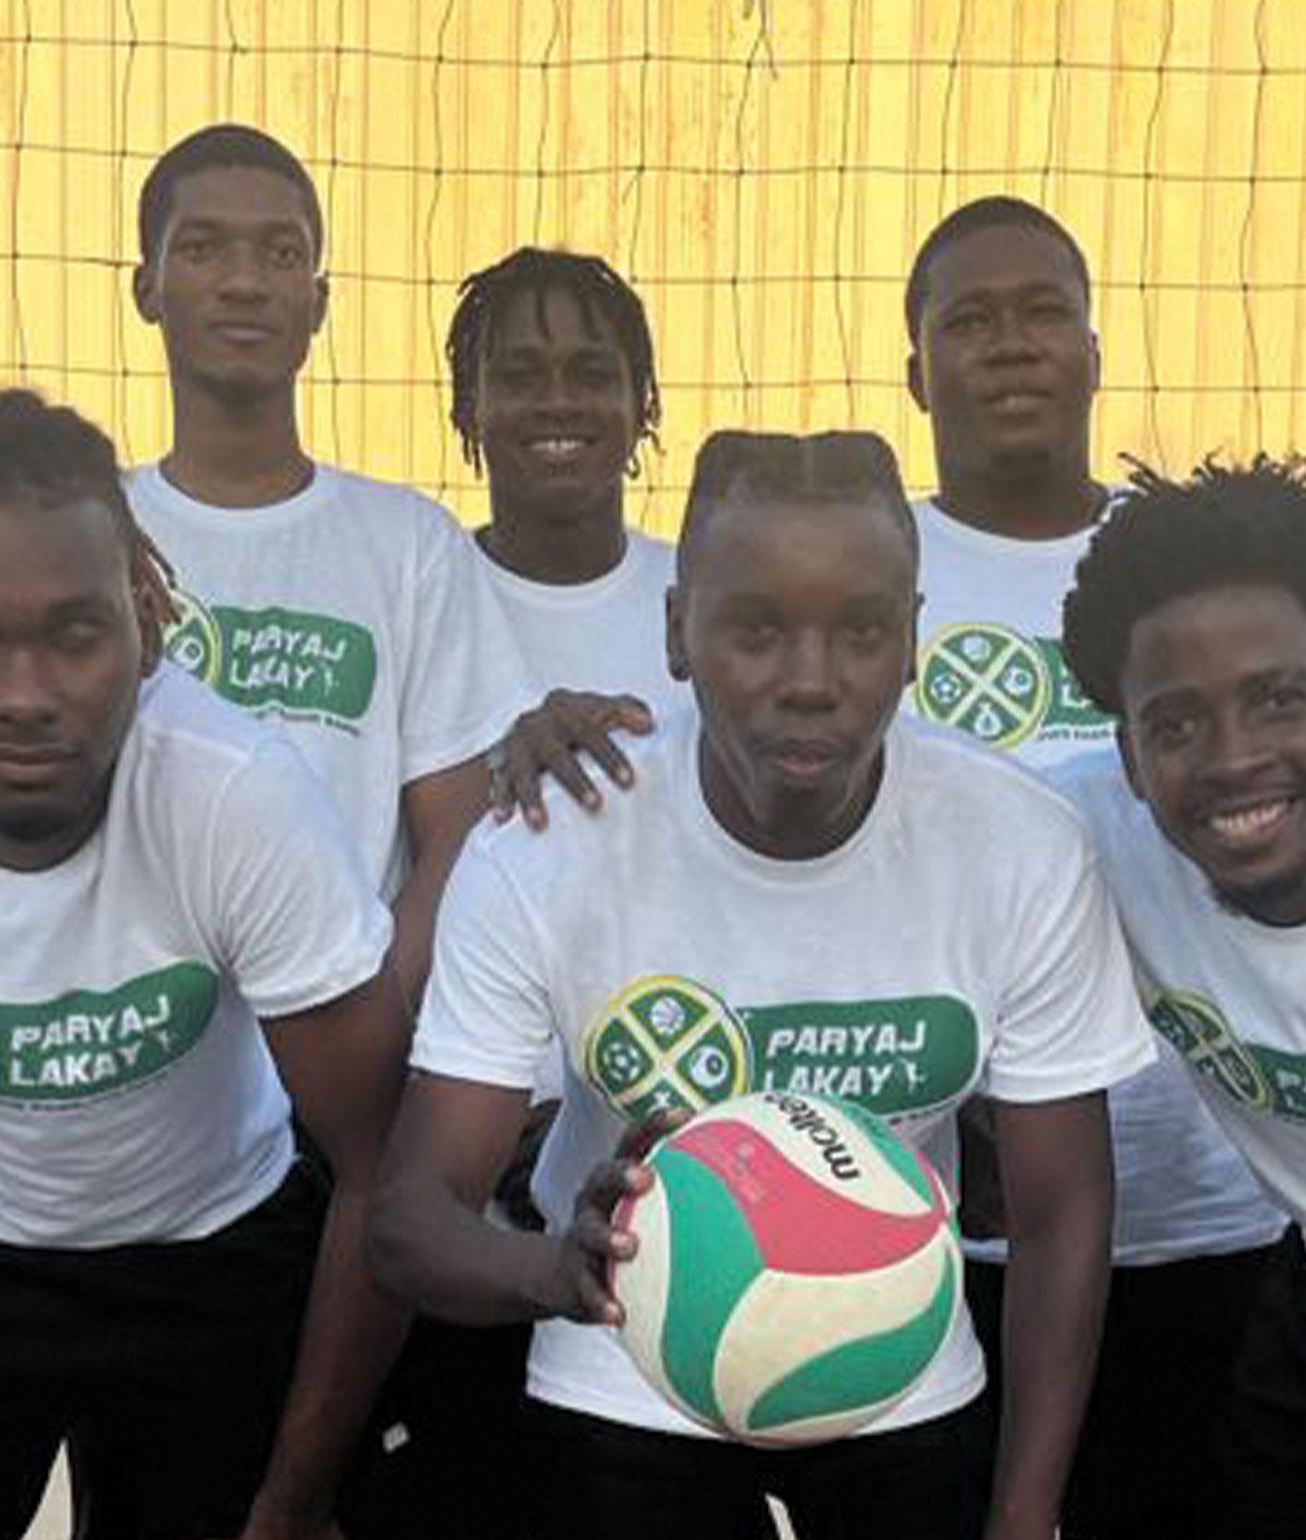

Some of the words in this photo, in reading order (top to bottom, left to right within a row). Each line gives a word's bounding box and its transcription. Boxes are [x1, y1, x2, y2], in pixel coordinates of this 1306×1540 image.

[11, 994, 170, 1049] PARYAJ
[766, 1020, 926, 1057] PARYAJ
[10, 1042, 143, 1087] LAKAY
[763, 1094, 861, 1180] molte
